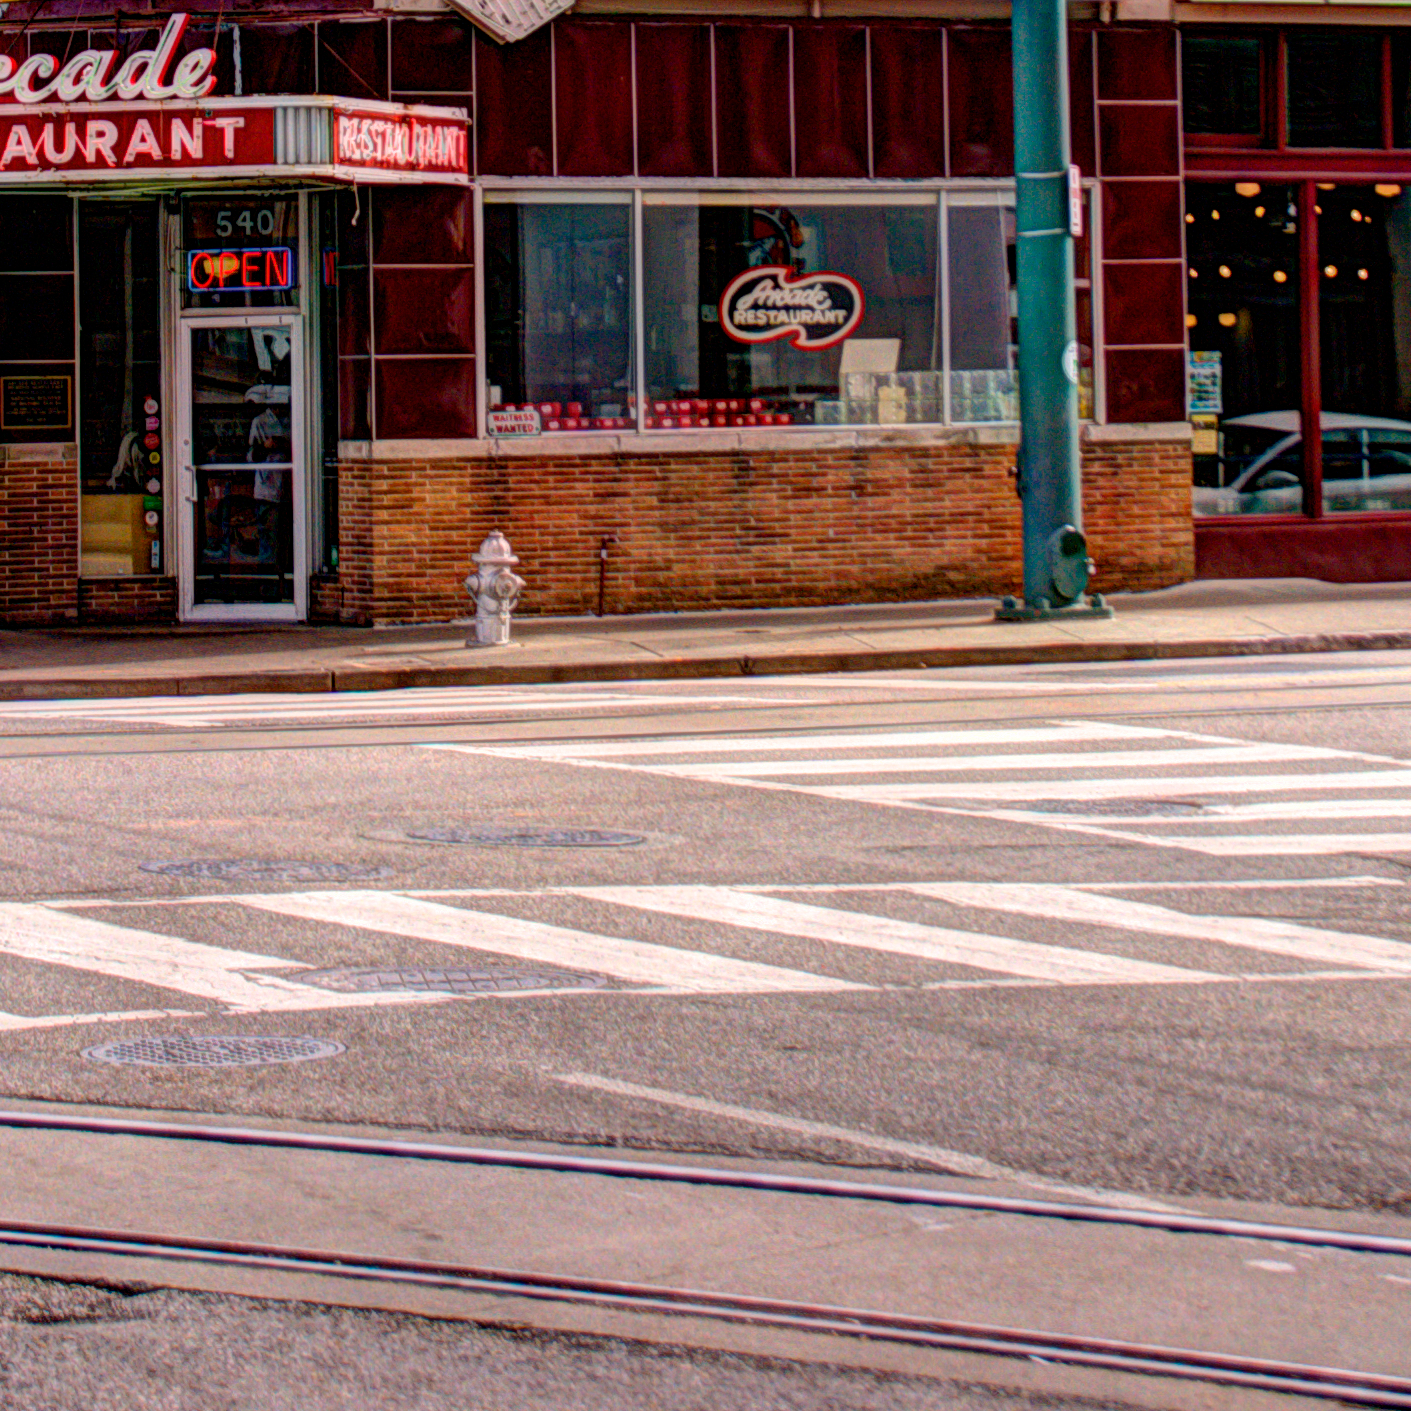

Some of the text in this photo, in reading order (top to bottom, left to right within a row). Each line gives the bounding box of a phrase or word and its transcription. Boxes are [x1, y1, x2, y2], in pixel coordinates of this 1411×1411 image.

[338, 115, 466, 168] RESTAURANT
[216, 209, 274, 237] 540
[190, 250, 289, 289] OPEN
[735, 278, 832, 309] Arcade
[733, 309, 849, 326] RESTAURANT
[493, 413, 535, 422] WAITRESS
[495, 423, 535, 433] WANTED
